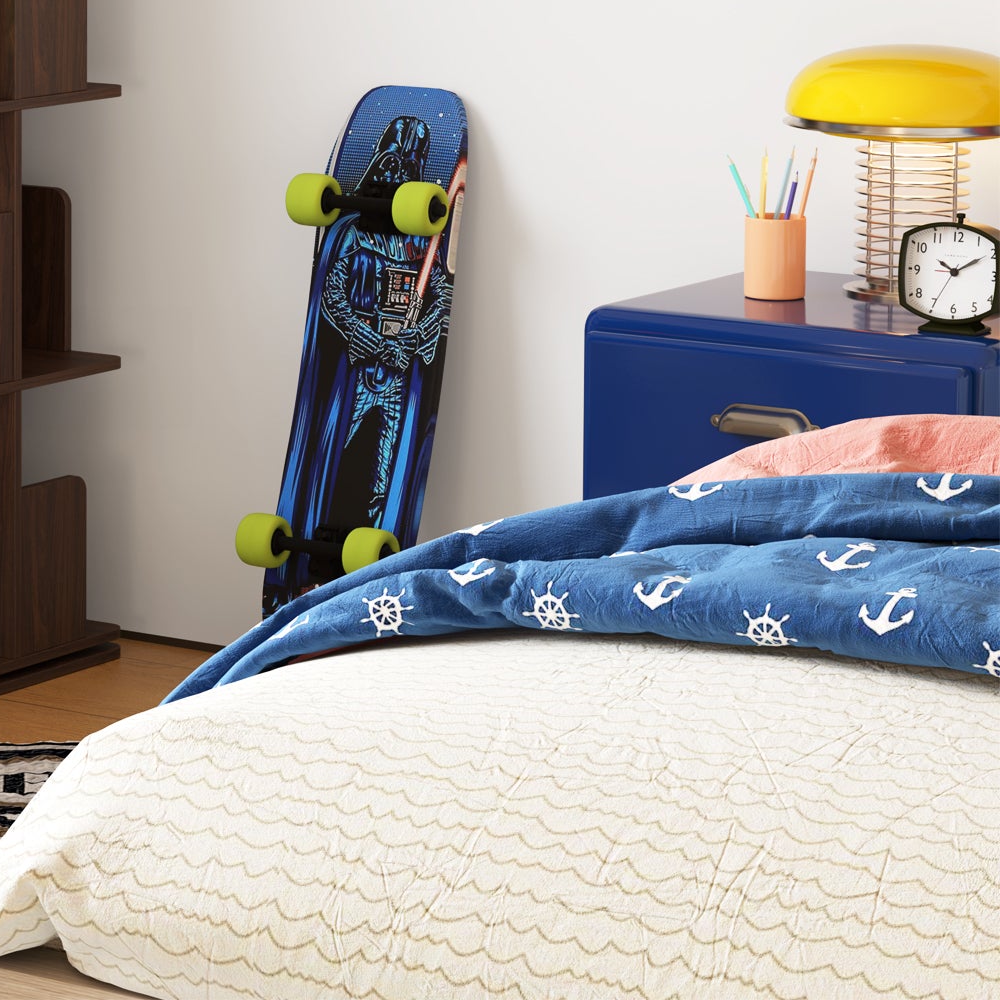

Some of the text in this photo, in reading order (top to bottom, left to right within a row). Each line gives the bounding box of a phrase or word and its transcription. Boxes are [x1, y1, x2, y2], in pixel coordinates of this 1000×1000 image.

[933, 232, 941, 244] 11
[953, 231, 964, 243] 12
[977, 236, 980, 247] 1
[916, 242, 928, 253] 10
[991, 249, 996, 259] 2
[914, 264, 920, 275] 9
[991, 271, 996, 282] 3
[915, 287, 922, 298] 8
[931, 298, 937, 308] 7
[971, 302, 977, 313] 5
[950, 304, 956, 314] 6
